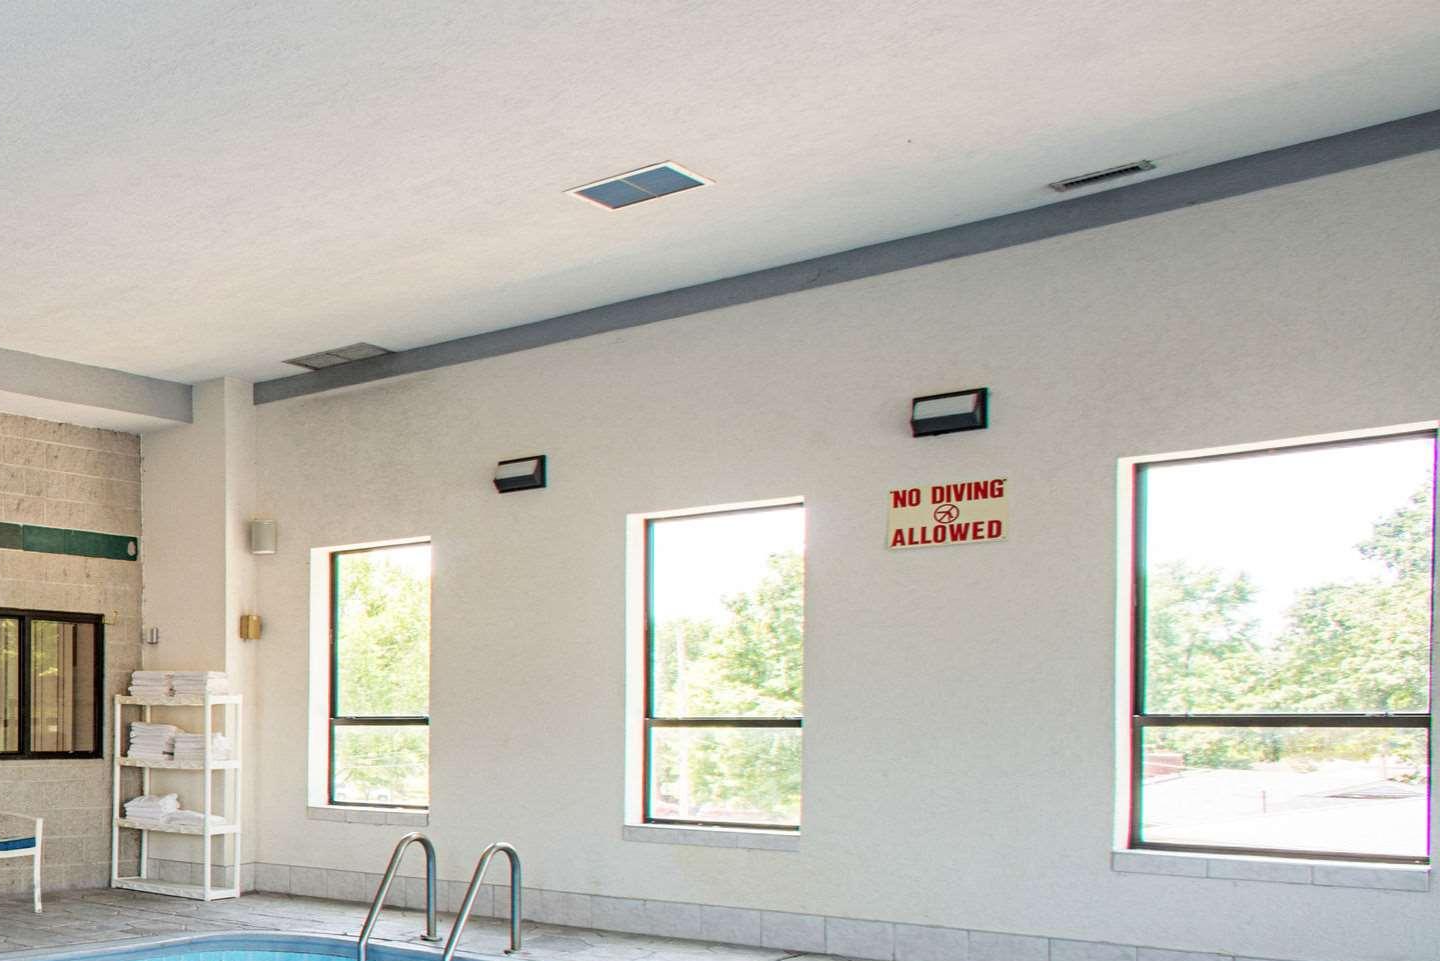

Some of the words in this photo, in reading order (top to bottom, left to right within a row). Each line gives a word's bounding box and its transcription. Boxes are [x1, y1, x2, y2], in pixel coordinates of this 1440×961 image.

[892, 488, 922, 509] NO
[931, 479, 1005, 504] DIVING
[890, 520, 1003, 547] ALLOWED
